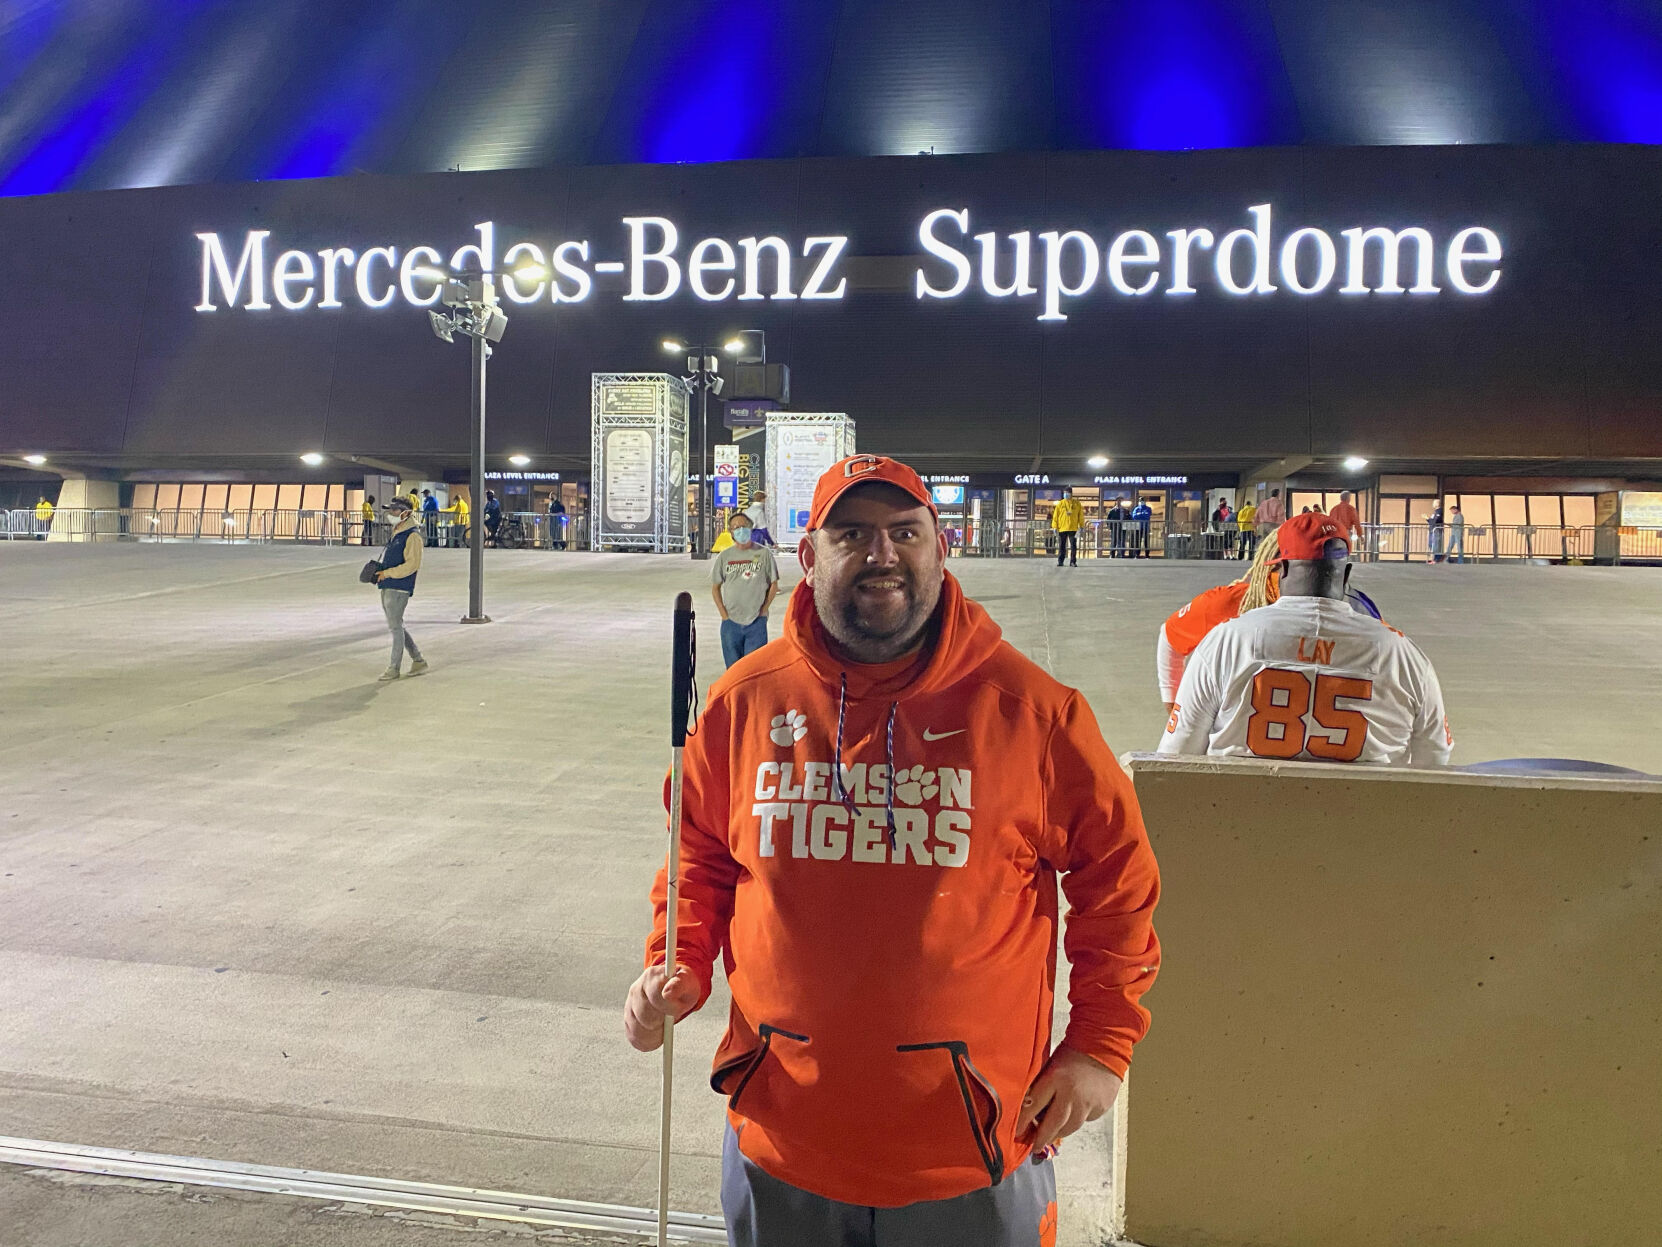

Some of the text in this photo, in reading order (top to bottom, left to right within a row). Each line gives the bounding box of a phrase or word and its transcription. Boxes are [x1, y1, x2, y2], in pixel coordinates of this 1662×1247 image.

[195, 203, 1505, 321] Mercedes-Benz Superdome
[484, 472, 560, 480] LAZA LEVEL ENTRANCE
[738, 453, 750, 479] BIG
[930, 475, 970, 483] ENTRANCE
[1014, 474, 1050, 484] GATE A
[1094, 475, 1188, 484] PLAZA LEVEL ENTRANCE
[1297, 637, 1336, 666] LAY
[1246, 667, 1373, 762] 85
[752, 802, 972, 868] TIGERS
